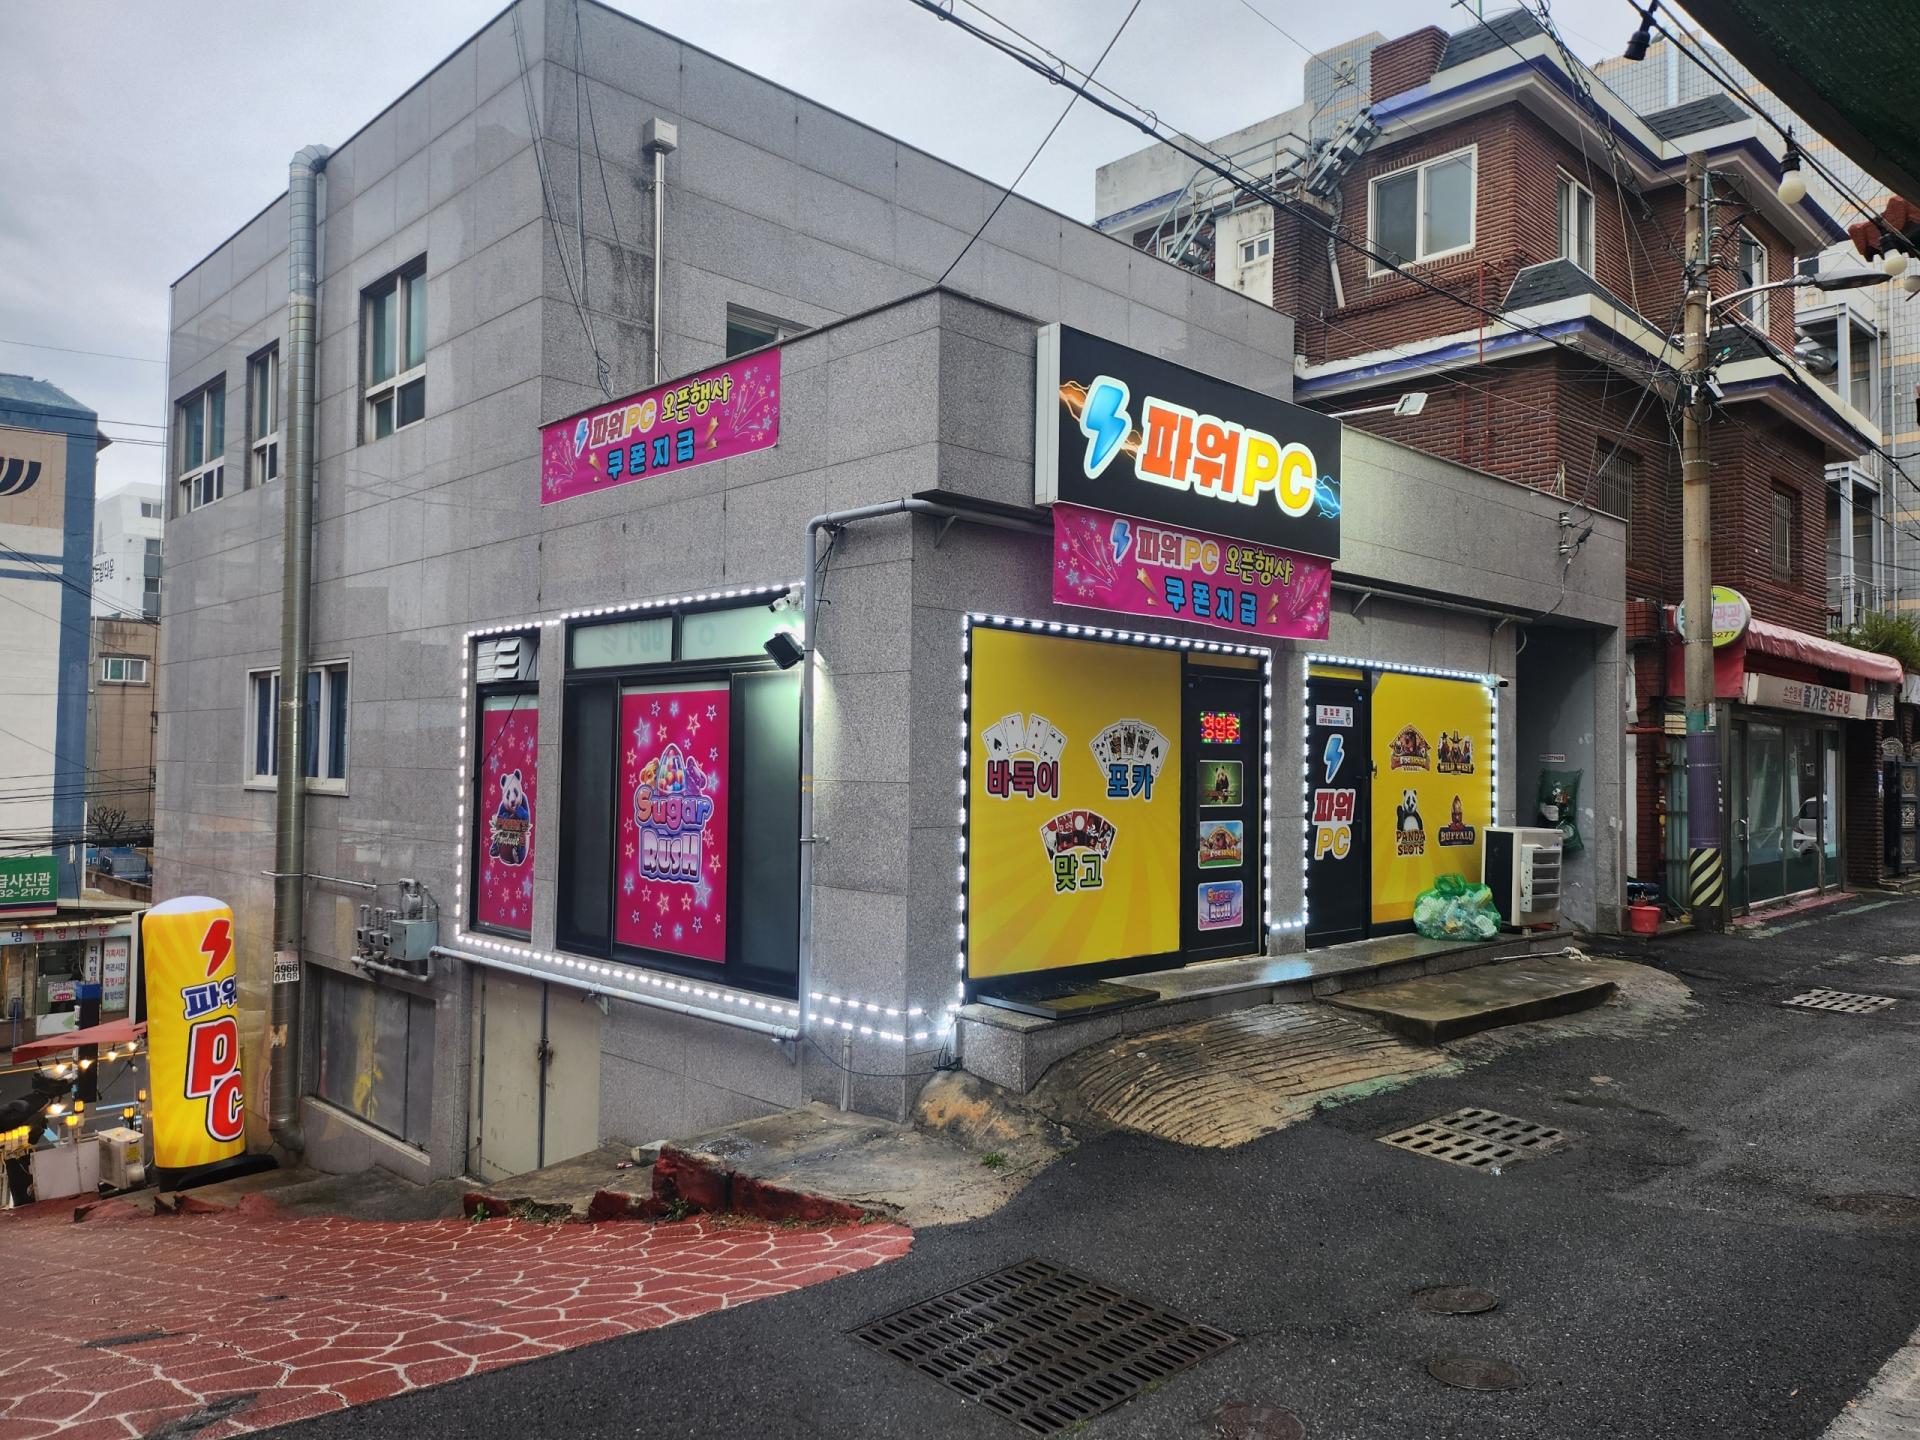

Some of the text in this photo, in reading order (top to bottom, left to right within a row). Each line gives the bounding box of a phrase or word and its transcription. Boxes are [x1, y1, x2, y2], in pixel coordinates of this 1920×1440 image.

[590, 373, 733, 449] 파워PC 오픈행사
[1137, 400, 1315, 514] 파워PC
[1136, 527, 1294, 586] 파워PC 오픈행사
[1828, 690, 1851, 714] 공부방
[1203, 715, 1237, 739] 영업중
[987, 759, 1060, 798] 바둑이
[1107, 763, 1154, 800] 포카
[636, 785, 712, 831] Sugar
[1313, 791, 1355, 822] 파워
[642, 830, 699, 876] RUSH
[1316, 826, 1350, 857] PC
[1396, 830, 1425, 842] PANDA
[1397, 844, 1424, 855] SLOTS
[1440, 831, 1474, 841] BUFFALO
[1055, 854, 1103, 892] 맞고
[274, 964, 298, 973] 4966
